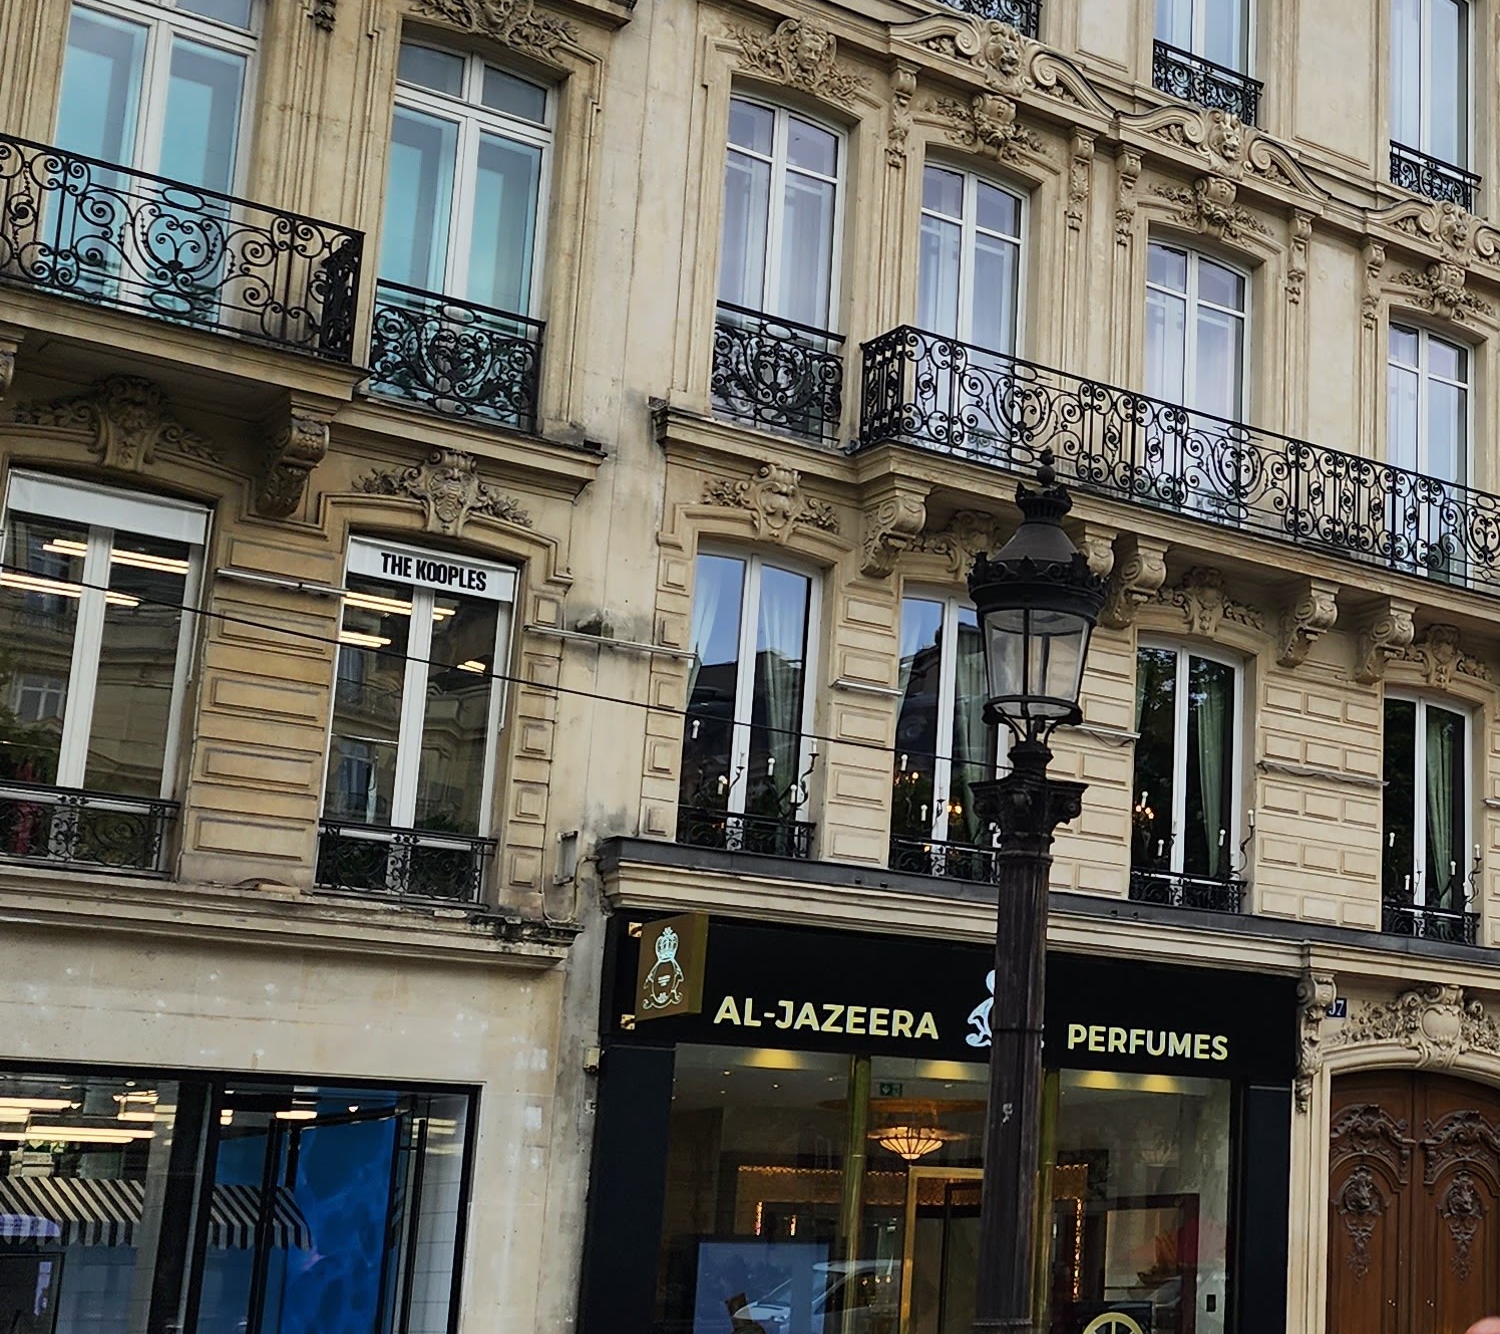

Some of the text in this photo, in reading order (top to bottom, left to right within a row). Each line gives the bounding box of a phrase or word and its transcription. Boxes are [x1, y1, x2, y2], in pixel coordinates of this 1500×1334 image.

[381, 552, 487, 592] THE KOOPLES
[713, 994, 1229, 1061] AL-JAZEERA PERFUMES
